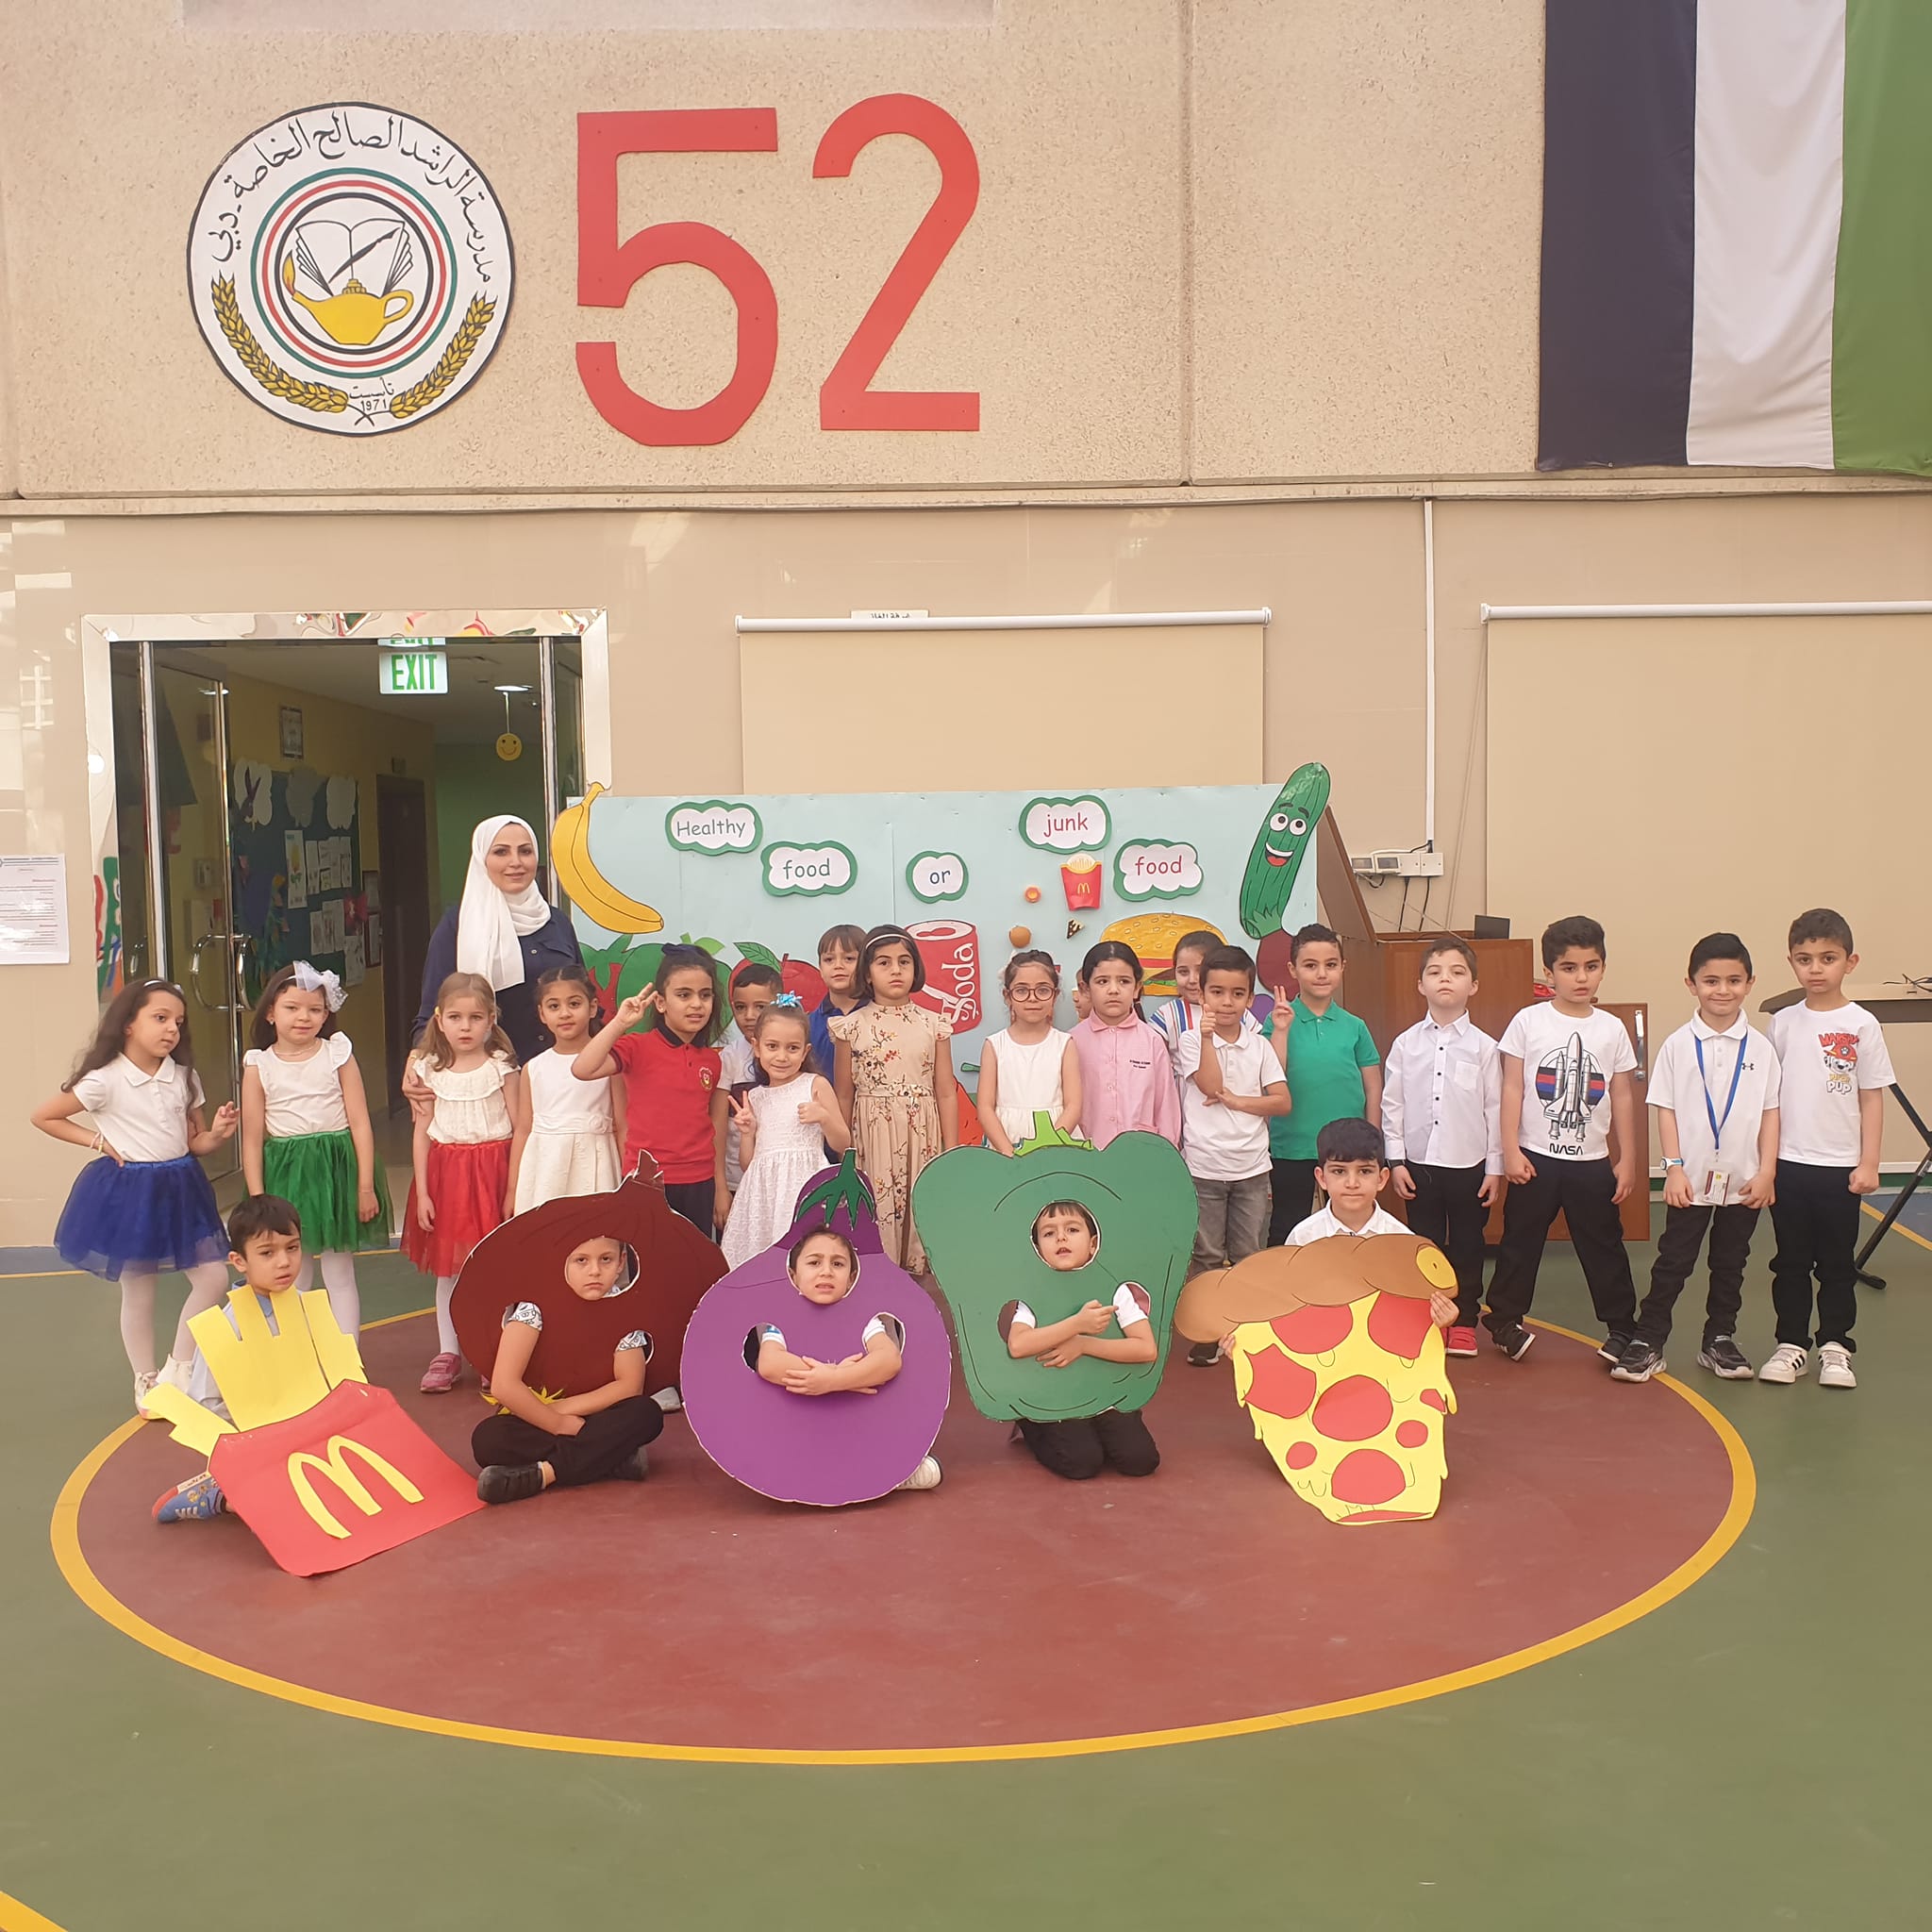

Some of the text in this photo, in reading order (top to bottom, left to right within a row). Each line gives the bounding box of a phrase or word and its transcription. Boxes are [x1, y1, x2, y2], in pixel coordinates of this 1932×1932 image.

[313, 110, 403, 159] الصالح
[224, 117, 311, 198] الخاصة
[400, 141, 477, 197] الراشد
[460, 192, 493, 283] مدرسة
[575, 92, 980, 447] 52
[360, 398, 387, 412] 1971
[391, 654, 437, 690] EXIT
[676, 818, 745, 838] Healthy
[1043, 812, 1089, 837] junk
[783, 858, 830, 880] food
[929, 870, 951, 884] or
[1135, 855, 1182, 875] food
[941, 942, 977, 1024] Soda
[1826, 1080, 1852, 1094] PUP
[1549, 1142, 1584, 1156] NASA
